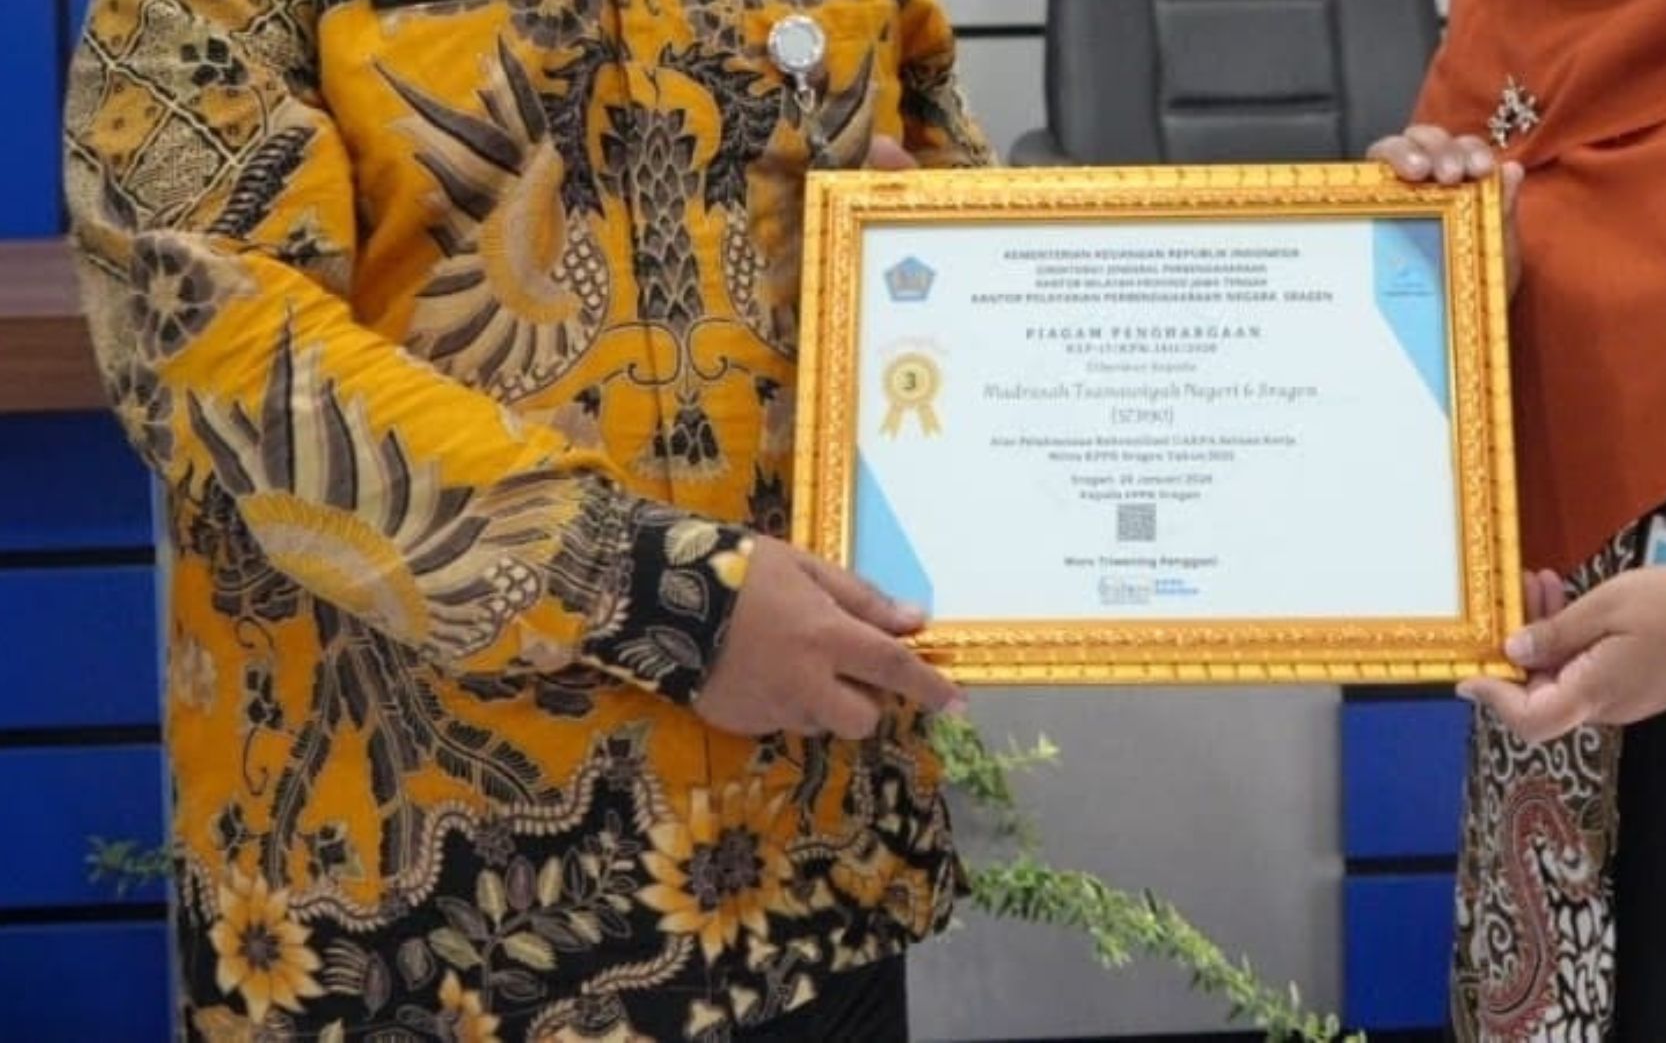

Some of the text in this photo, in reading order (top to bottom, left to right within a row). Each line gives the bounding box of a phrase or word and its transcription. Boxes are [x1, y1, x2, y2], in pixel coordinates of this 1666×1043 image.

[1004, 248, 1299, 260] KEMENTERIAN KEUANGAN REPUBLIK INDONESIA
[1107, 264, 1158, 274] JENDERAL
[1162, 264, 1267, 274] PERBENDAHARAAN
[1035, 278, 1081, 288] KANTOR
[1084, 278, 1134, 288] WILAYAH
[1189, 278, 1220, 288] JAWA
[1223, 277, 1267, 287] TENGAH
[971, 290, 1333, 303] KANTOR PELAYANAN PERBENDAHARAAN NEGARA SRAGEN
[1026, 326, 1261, 340] PIAGAM PENGHARGAAN
[902, 371, 917, 392] 3
[983, 381, 1069, 399] Madrasah
[1184, 381, 1239, 403] Negeri
[1244, 382, 1255, 398] 6
[1257, 381, 1317, 403] Sragen
